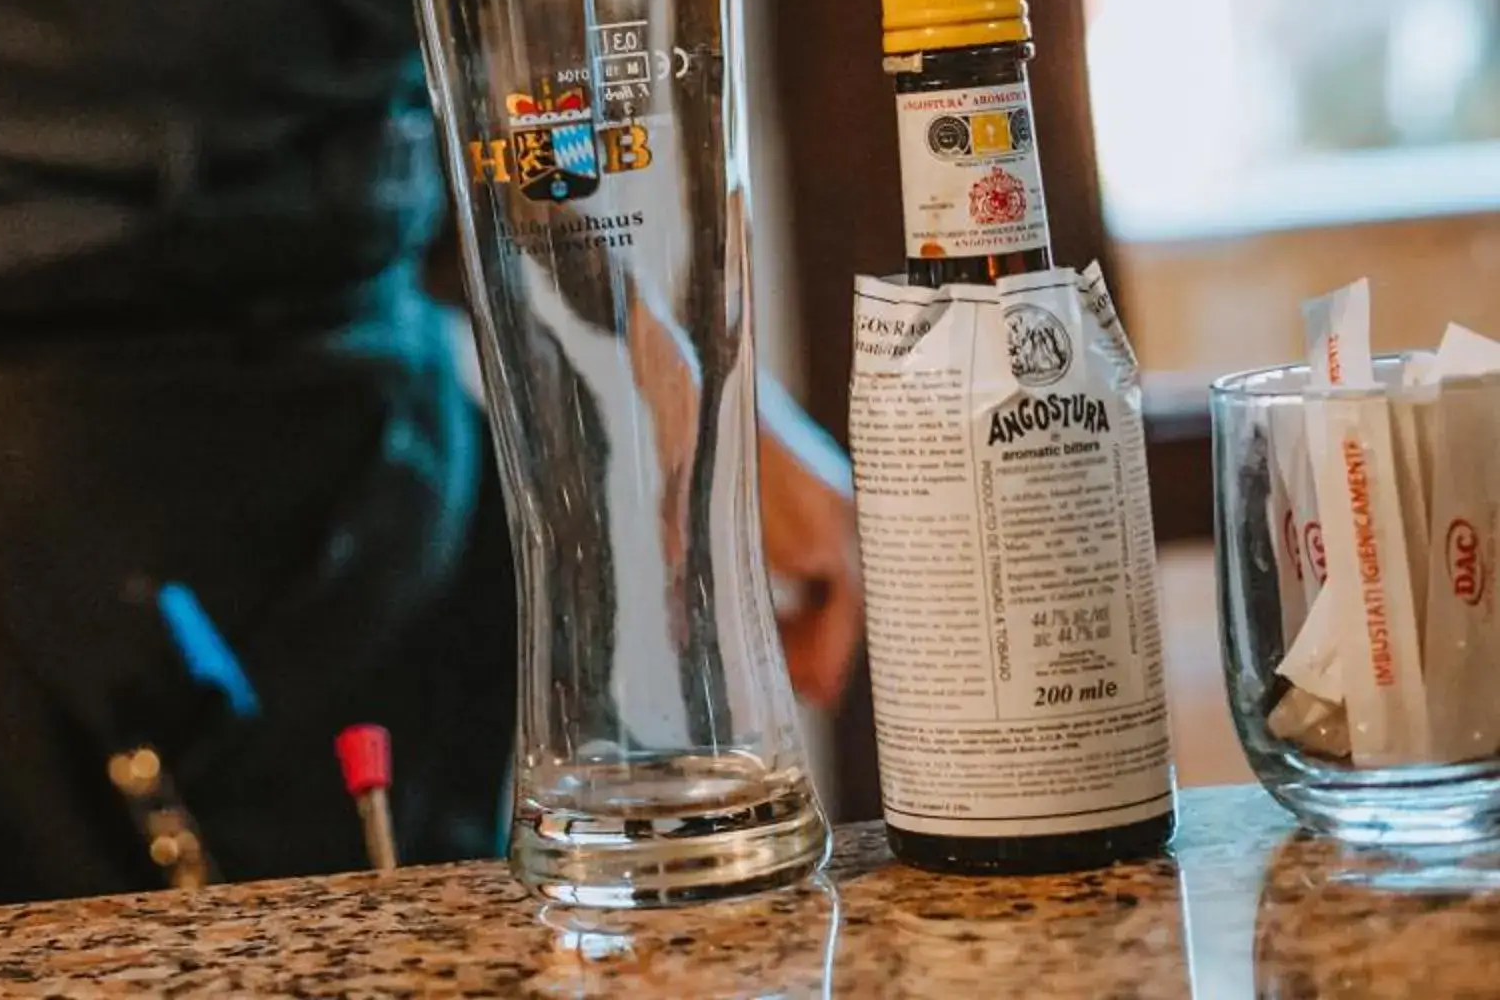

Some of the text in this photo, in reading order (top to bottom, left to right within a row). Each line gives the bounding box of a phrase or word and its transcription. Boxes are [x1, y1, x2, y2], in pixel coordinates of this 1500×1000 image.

[469, 124, 653, 183] H B
[987, 393, 1111, 447] ANGOSTURA
[1001, 441, 1102, 462] aromatic bitters
[1454, 531, 1479, 597] DAC
[1363, 590, 1396, 687] IMBUSTATI
[1033, 684, 1074, 707] 200
